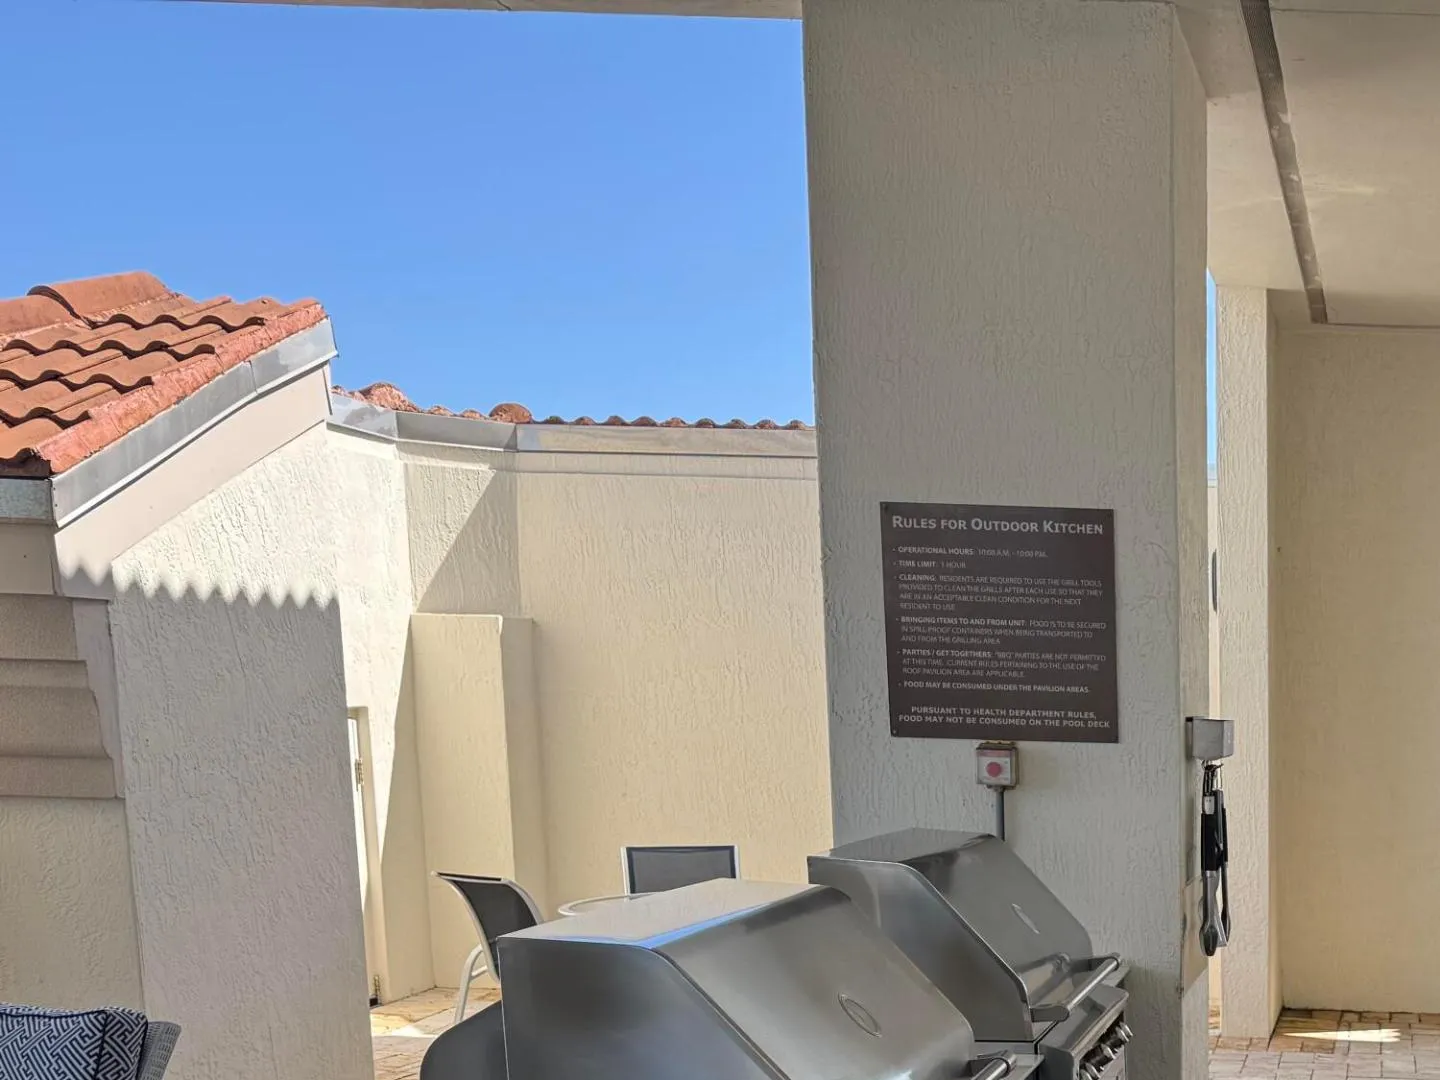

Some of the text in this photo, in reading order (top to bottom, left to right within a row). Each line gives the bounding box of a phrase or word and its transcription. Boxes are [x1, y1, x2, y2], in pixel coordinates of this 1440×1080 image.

[892, 515, 1103, 535] RULES FOR OUTDOOR KITCHEN
[911, 706, 957, 714] PURSUANT
[960, 707, 971, 715] TO
[973, 708, 1007, 717] HEALTH
[1009, 709, 1065, 718] DEPARTMENT
[899, 714, 923, 722] FOOD
[925, 715, 944, 723] MAY
[945, 716, 964, 724] NOT
[966, 716, 977, 724] BE
[979, 717, 1027, 726] CONSUMED
[1044, 719, 1061, 727] THE
[1062, 719, 1086, 728] POOL
